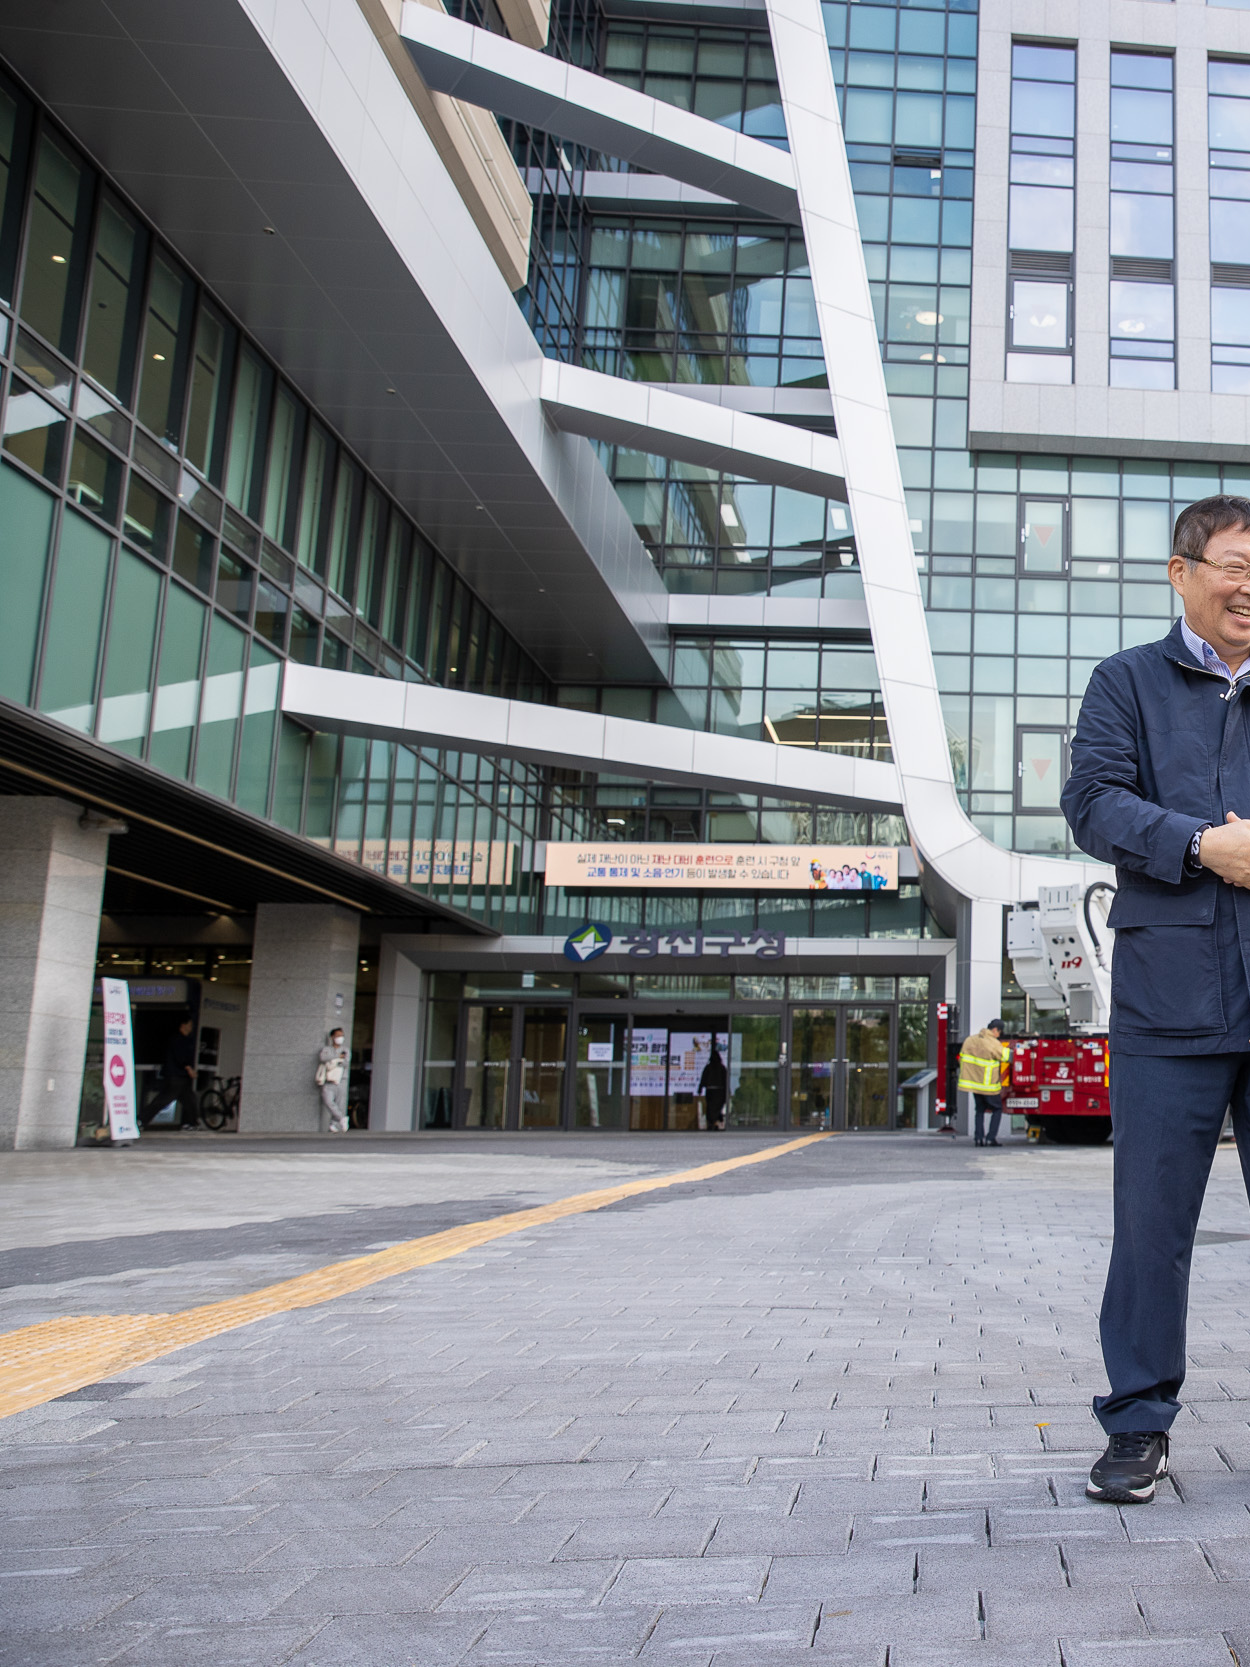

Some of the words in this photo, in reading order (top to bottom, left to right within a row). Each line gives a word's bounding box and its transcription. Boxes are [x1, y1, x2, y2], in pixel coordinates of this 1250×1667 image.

[652, 854, 672, 865] 재난
[674, 854, 694, 866] 대비
[695, 855, 734, 866] 훈련으로
[620, 928, 786, 961] 광진구청
[1061, 956, 1083, 969] 119
